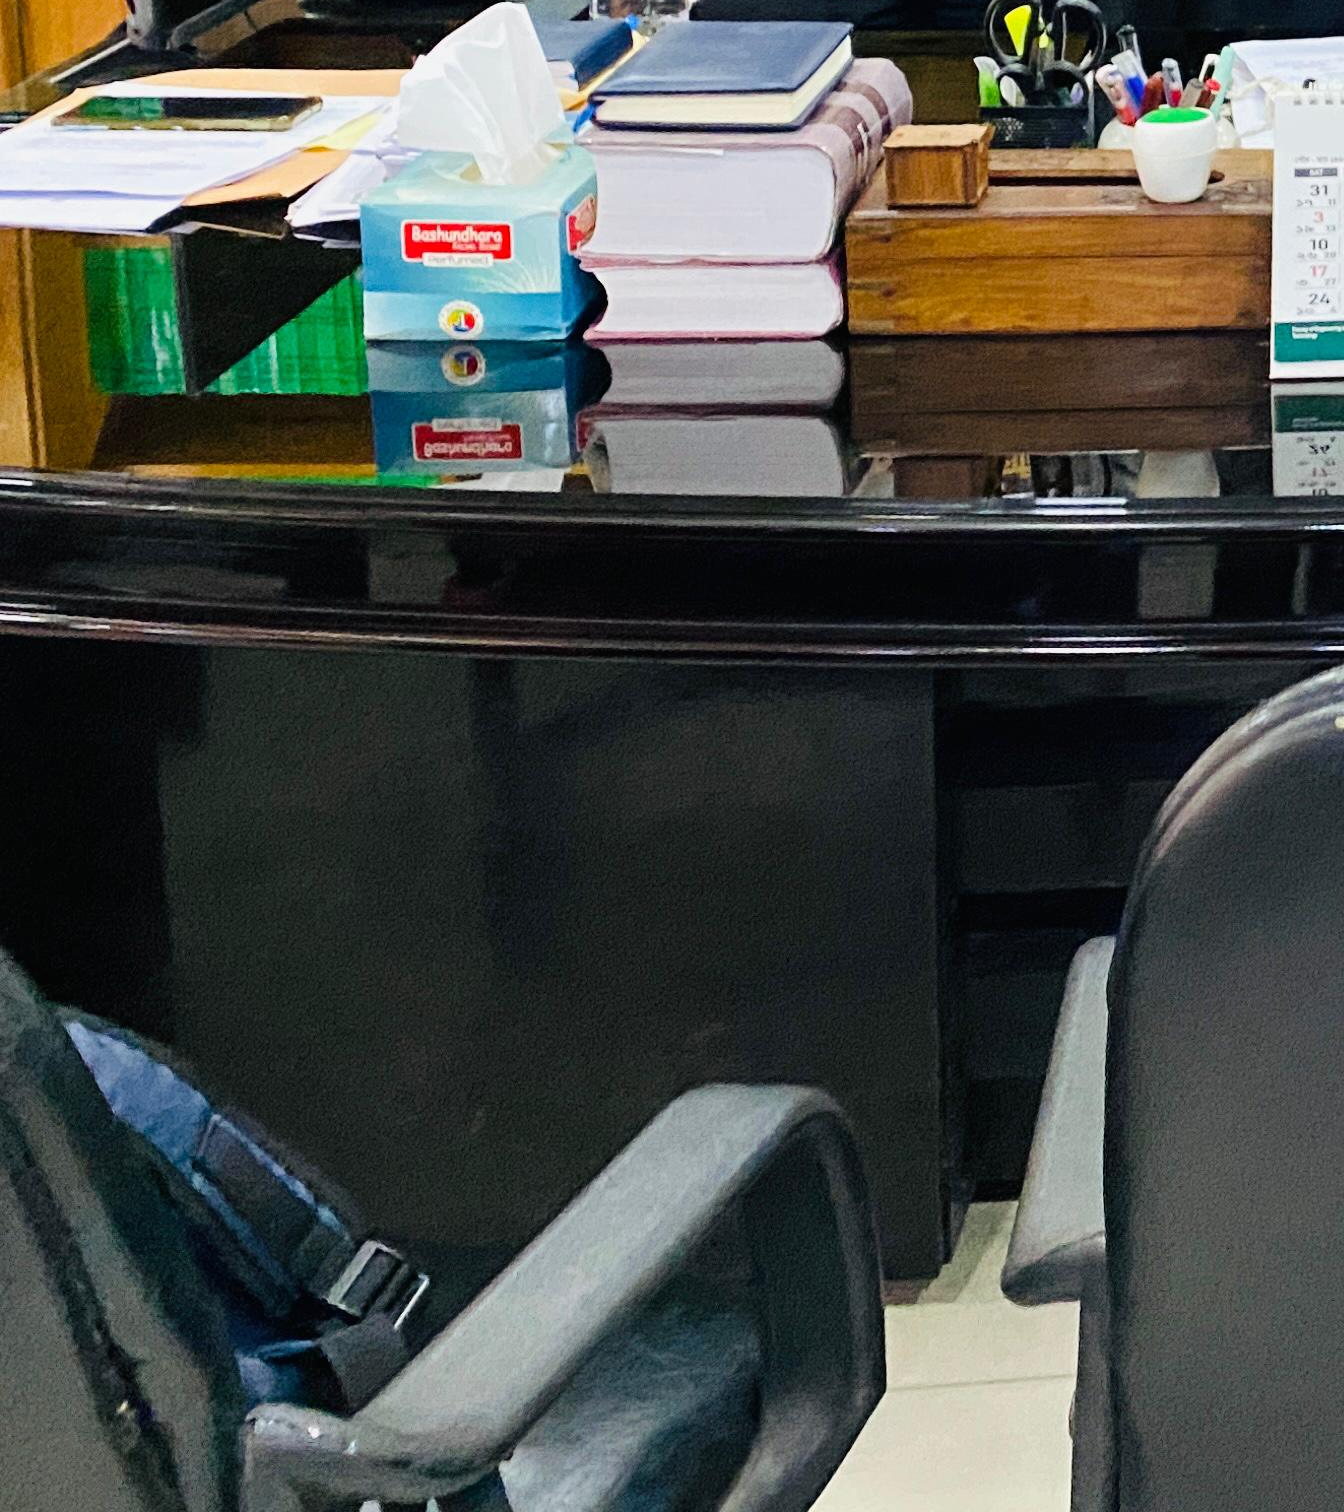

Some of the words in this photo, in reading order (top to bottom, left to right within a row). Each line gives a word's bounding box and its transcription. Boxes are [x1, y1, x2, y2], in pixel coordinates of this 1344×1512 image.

[1310, 184, 1328, 196] 31
[1314, 211, 1324, 223] 3
[412, 225, 502, 243] Bashundhara
[1310, 238, 1328, 251] 10
[1310, 265, 1327, 277] 17
[1309, 293, 1330, 305] 24
